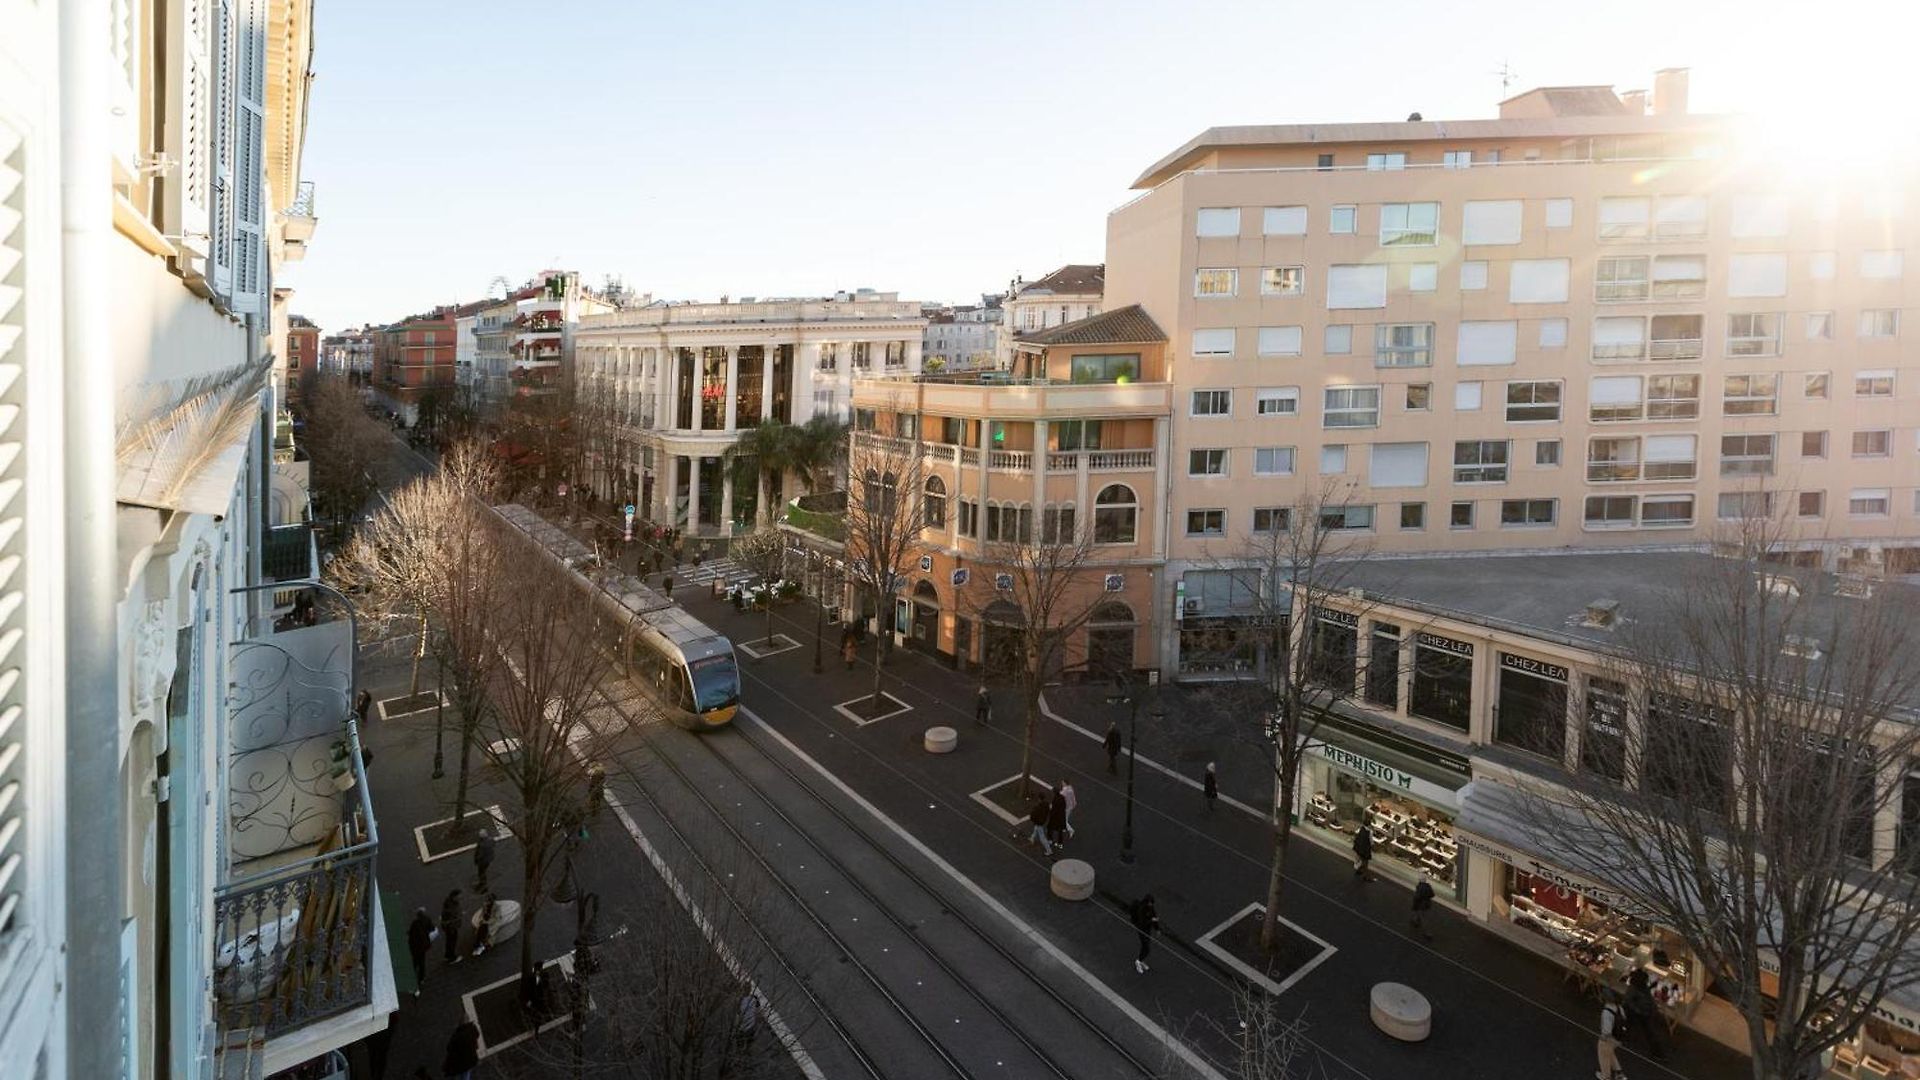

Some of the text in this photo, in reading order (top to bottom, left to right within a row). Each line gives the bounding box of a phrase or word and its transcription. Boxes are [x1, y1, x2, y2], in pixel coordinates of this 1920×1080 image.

[1421, 633, 1449, 649] CHEZ
[1505, 655, 1566, 679] CHEZ LEA
[1324, 744, 1393, 782] MEPHISTO
[1457, 834, 1513, 863] CHAUSSURES
